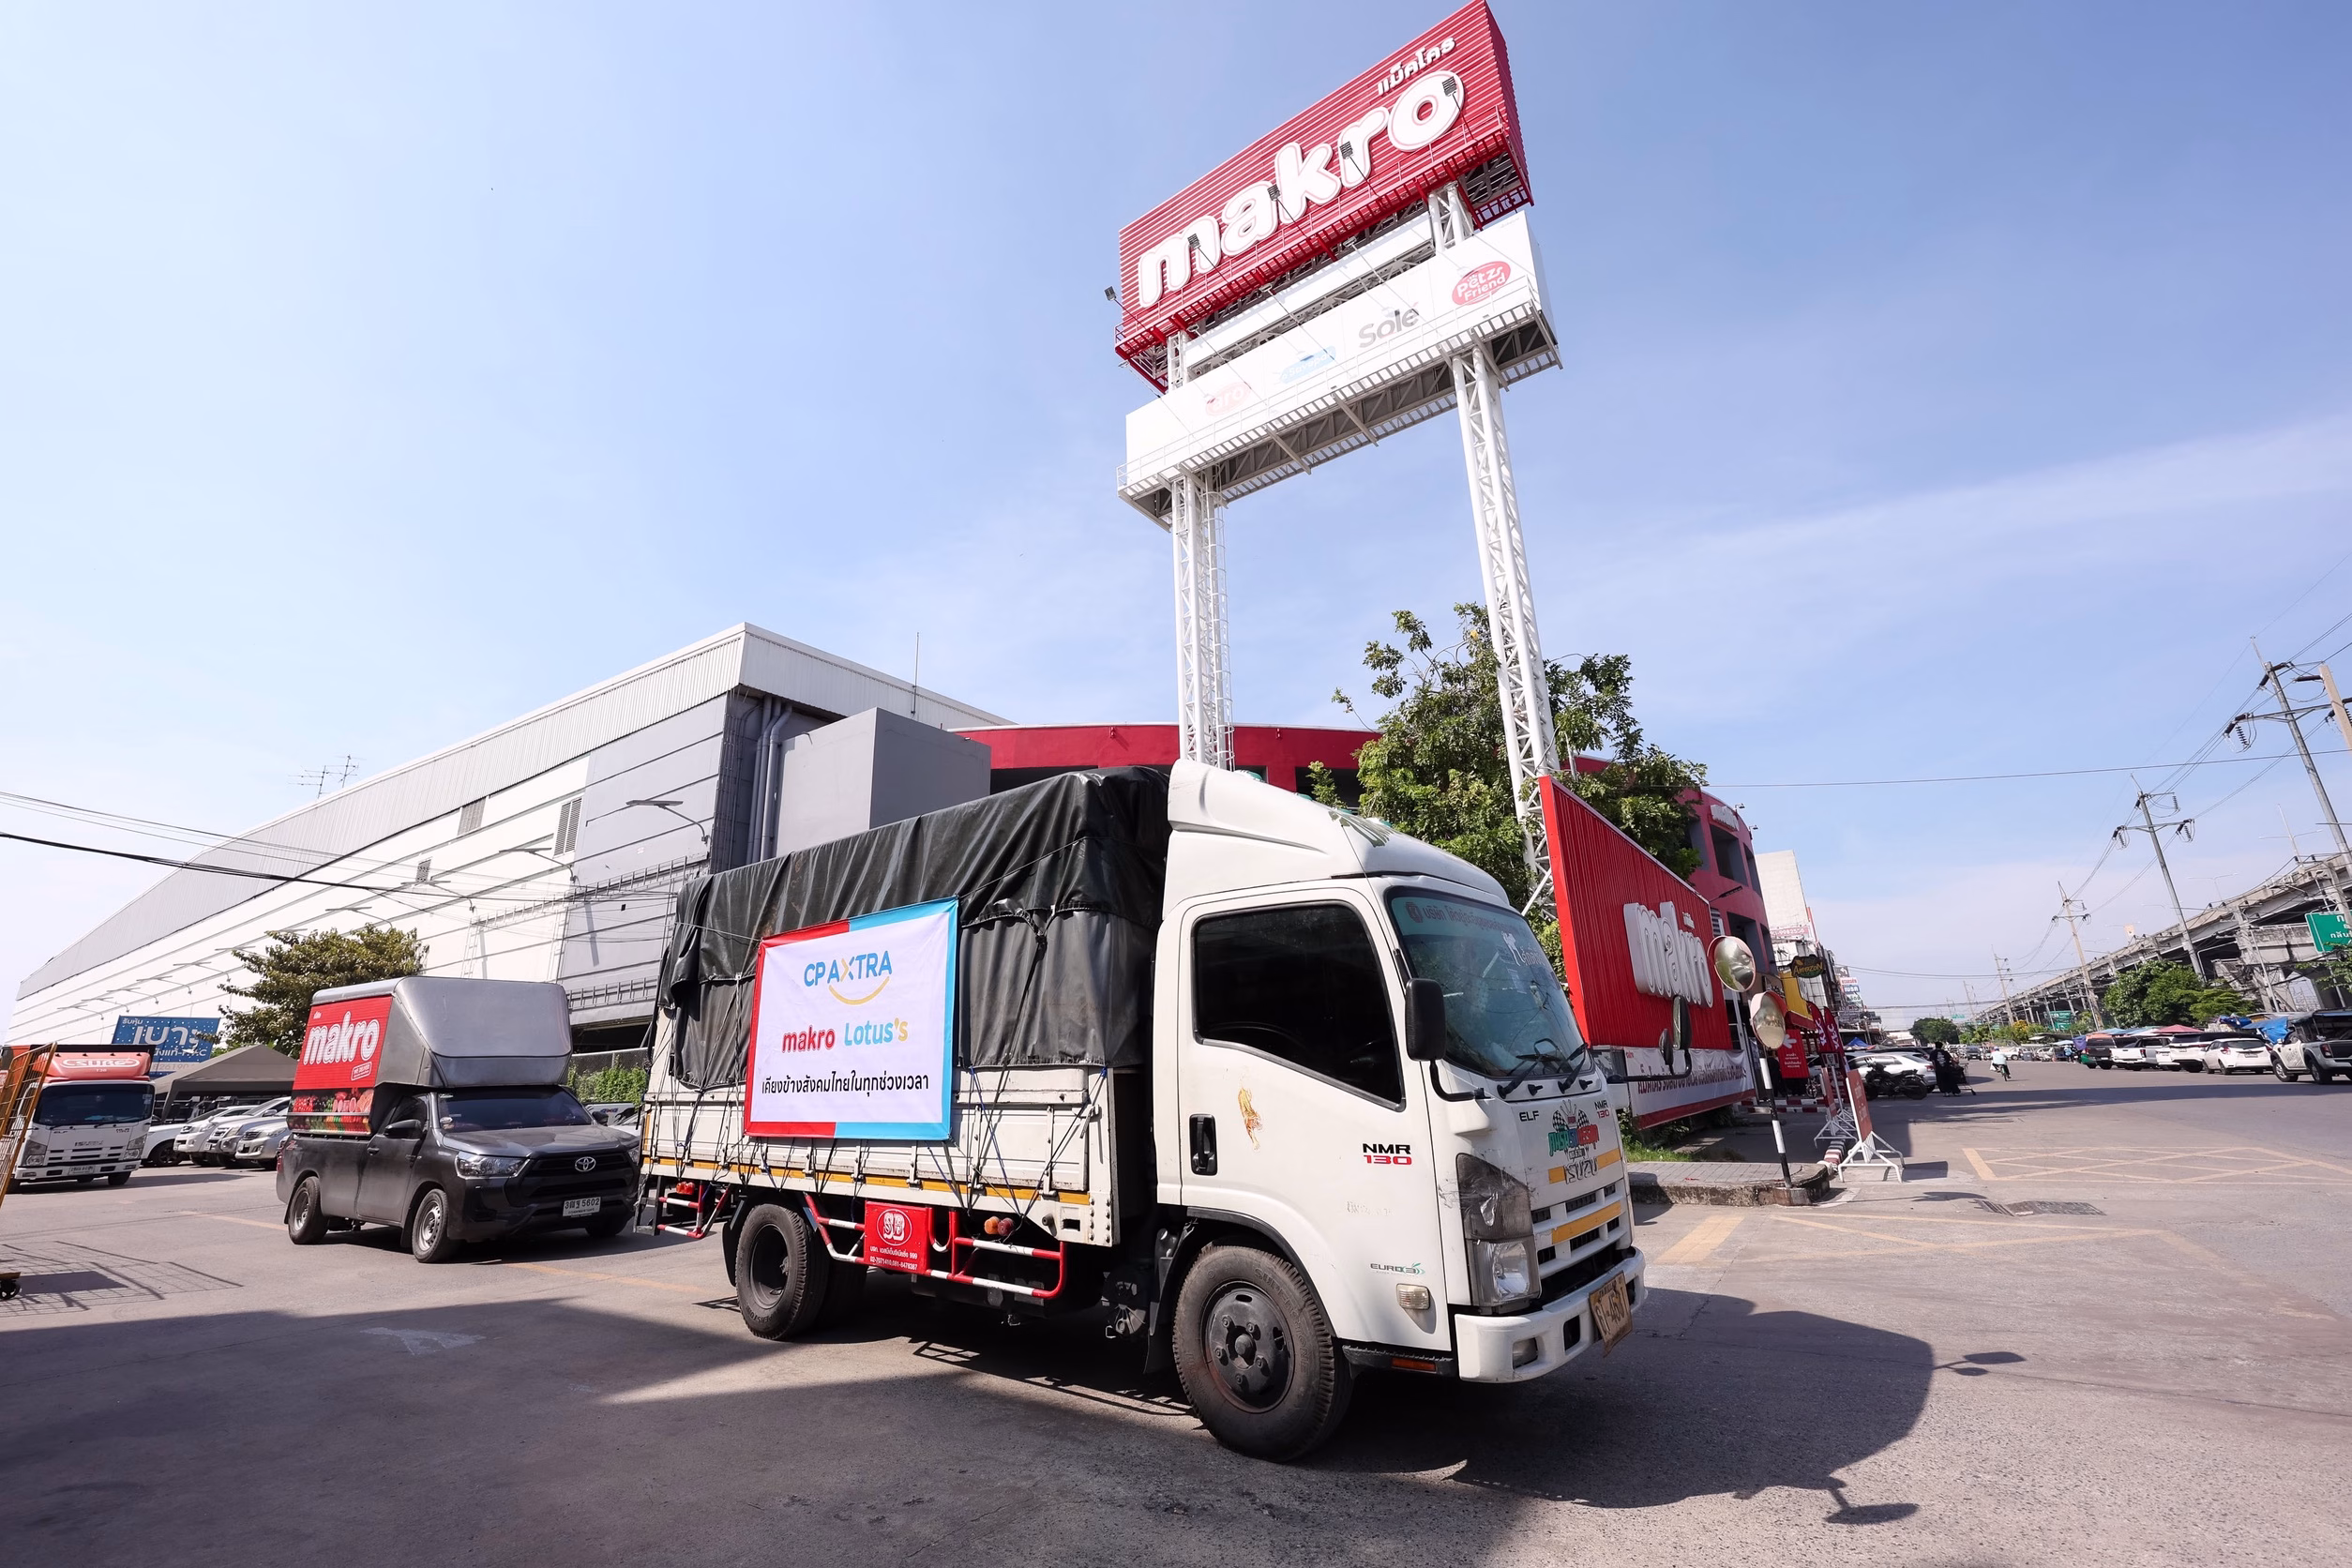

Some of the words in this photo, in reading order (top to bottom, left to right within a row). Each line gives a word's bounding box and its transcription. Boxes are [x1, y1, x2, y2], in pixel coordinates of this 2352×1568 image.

[1377, 37, 1455, 96] แม็คโคร
[1137, 70, 1465, 309] makro
[1464, 272, 1505, 300] Friend
[1623, 900, 1713, 1008] makro
[303, 1010, 380, 1065] makro
[781, 1025, 836, 1053] makro
[844, 1018, 909, 1046] Lotus's
[761, 1069, 929, 1097] เคียงข้างสังคมไทยในทุกช่วงเวลา
[1519, 1110, 1540, 1122] ELF
[1597, 1109, 1610, 1119] 130
[1363, 1143, 1411, 1154] NMR
[1364, 1154, 1412, 1166] 130
[581, 1198, 600, 1207] 5602
[882, 1212, 905, 1242] SB
